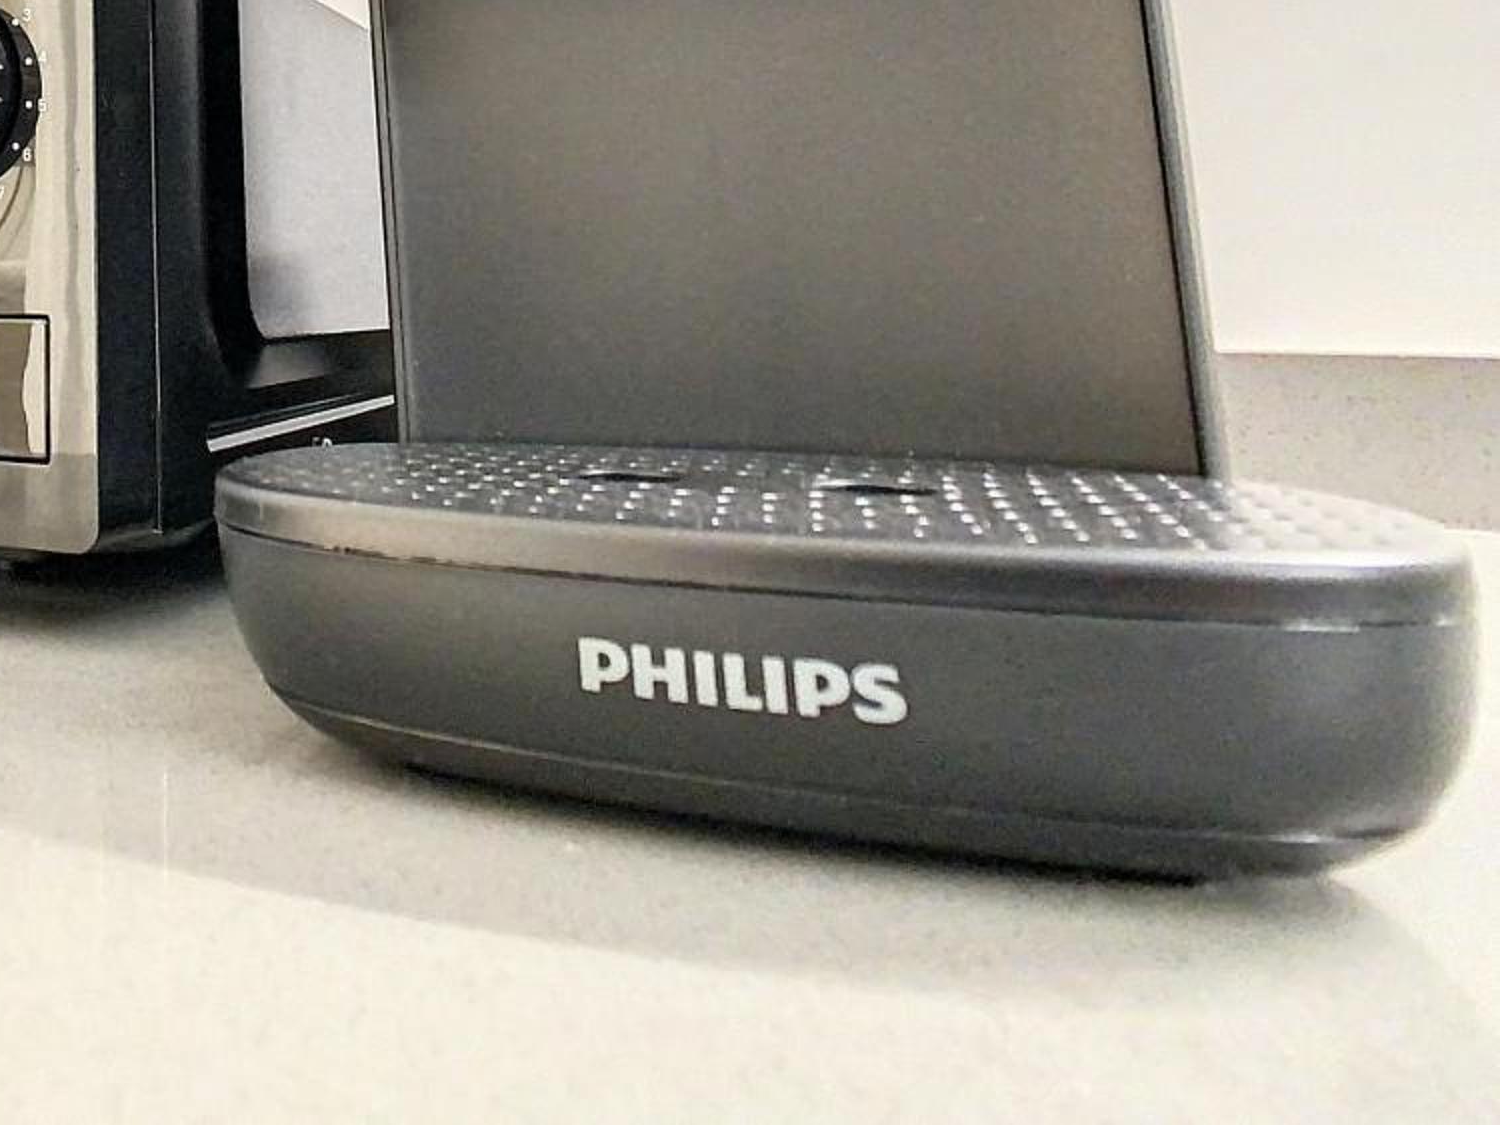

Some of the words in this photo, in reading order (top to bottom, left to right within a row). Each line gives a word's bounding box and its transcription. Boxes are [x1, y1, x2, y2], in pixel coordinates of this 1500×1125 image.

[22, 8, 32, 22] 3
[38, 50, 47, 62] 4
[37, 98, 47, 112] 5
[22, 147, 32, 162] 6
[577, 636, 908, 725] PHILIPS
